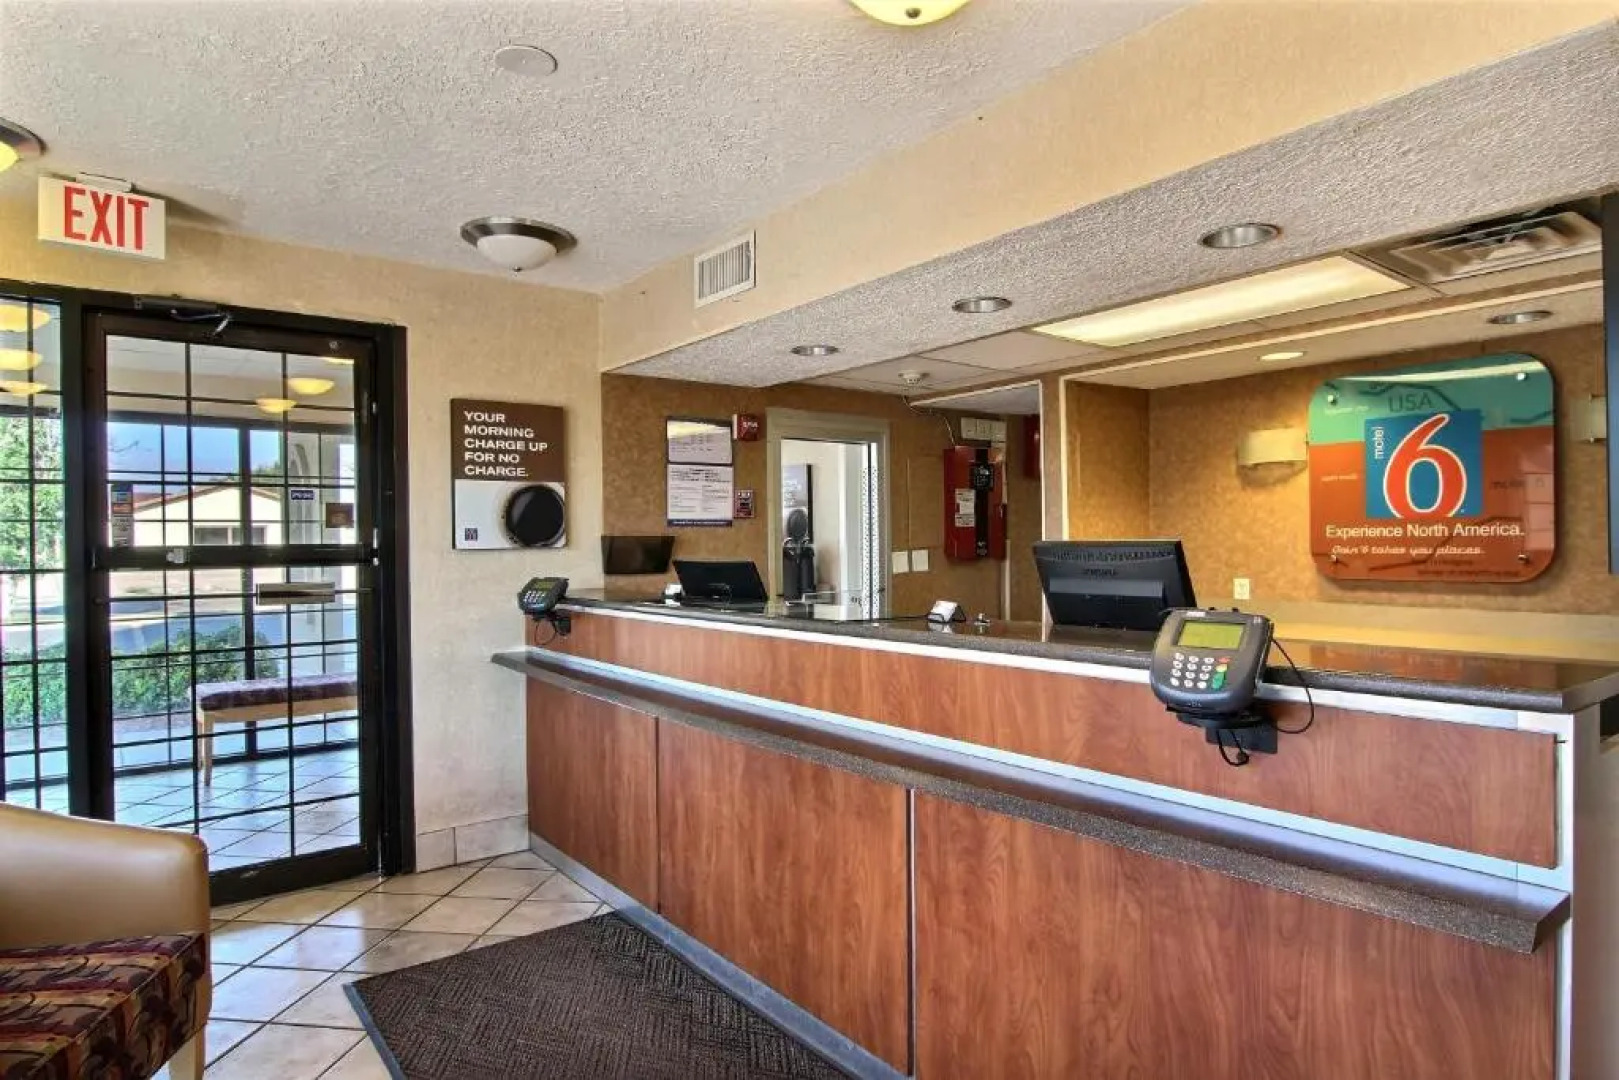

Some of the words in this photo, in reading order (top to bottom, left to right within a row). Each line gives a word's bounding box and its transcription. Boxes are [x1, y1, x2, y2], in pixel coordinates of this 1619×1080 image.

[64, 185, 149, 251] EXIT
[1388, 394, 1434, 413] USA
[464, 410, 506, 423] YOUR
[464, 425, 535, 439] MORNING
[464, 438, 526, 451] CHARGE
[529, 442, 548, 452] UP
[1371, 426, 1384, 460] motel
[464, 452, 496, 463] FOR
[498, 453, 520, 464] NO
[1383, 413, 1467, 519] 6
[464, 465, 529, 477] CHARGE.
[1325, 525, 1403, 541] Experience
[1406, 523, 1449, 537] North
[1453, 523, 1525, 537] America.
